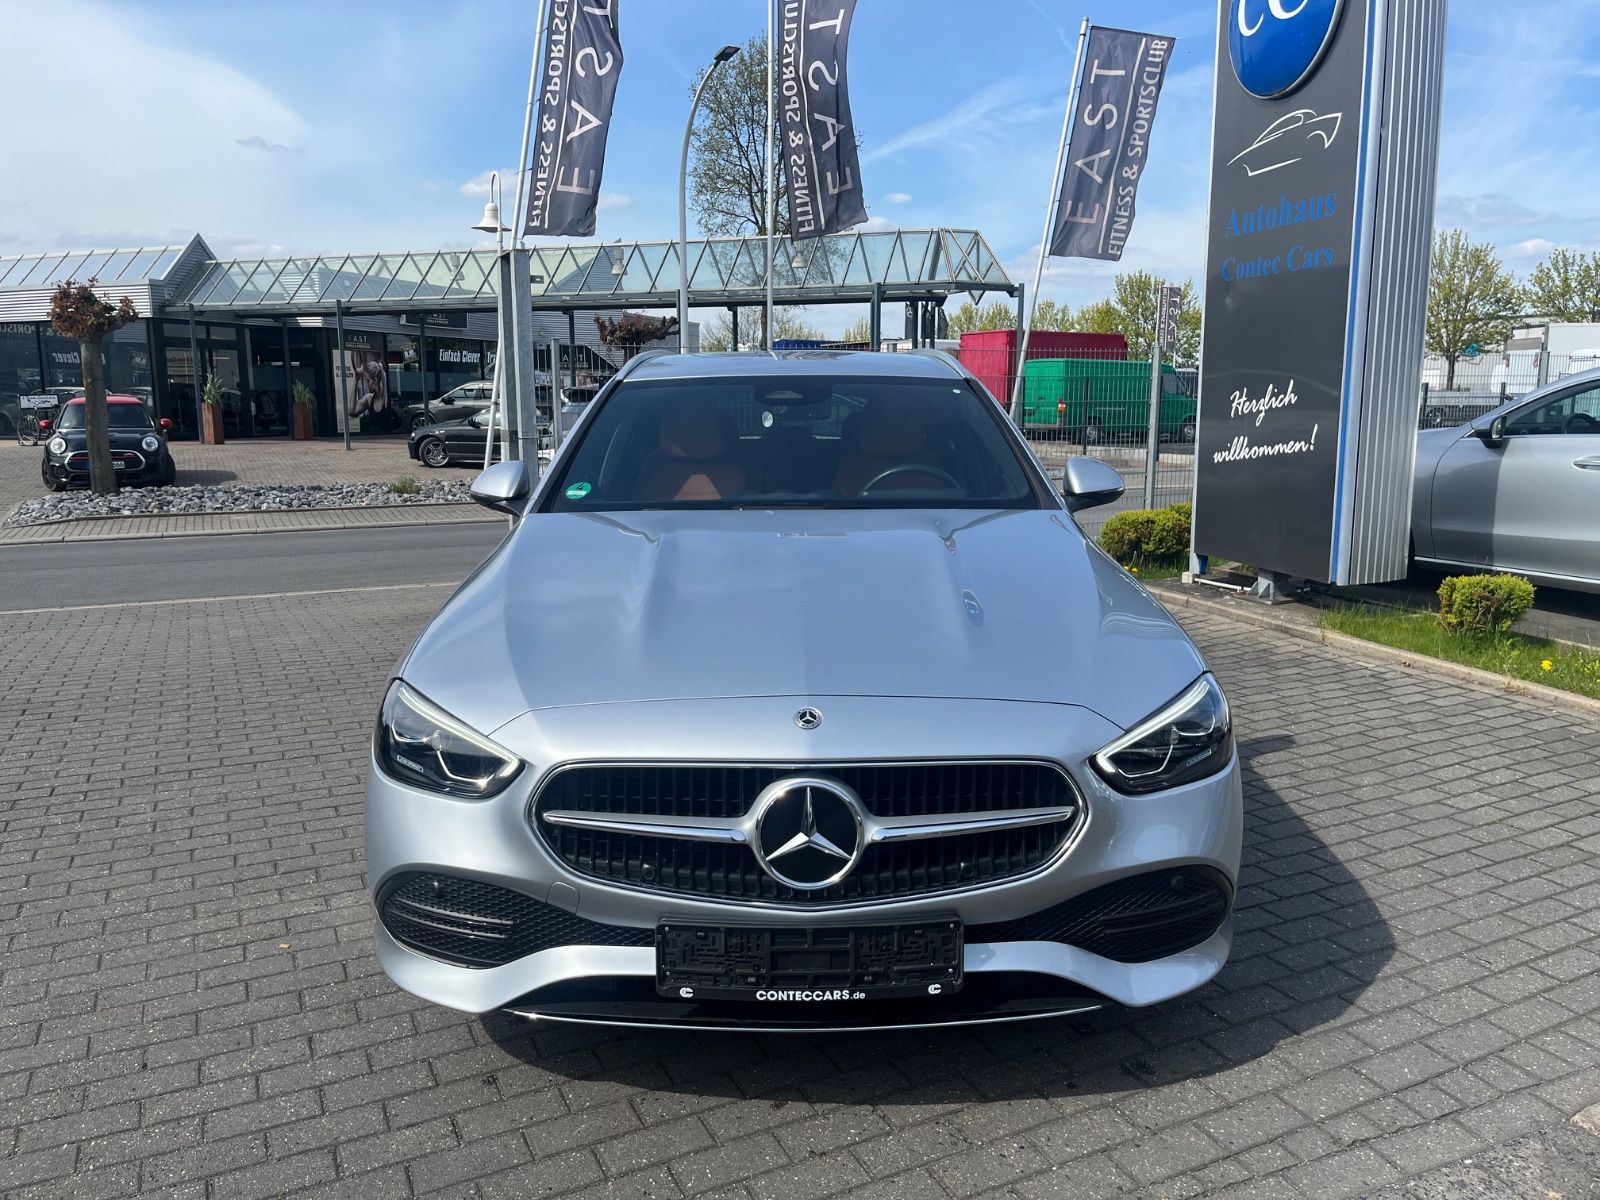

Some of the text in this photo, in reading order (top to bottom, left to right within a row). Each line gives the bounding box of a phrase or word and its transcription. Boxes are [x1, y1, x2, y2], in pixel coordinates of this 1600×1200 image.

[1066, 59, 1126, 224] EAST
[1108, 39, 1167, 255] FITNESS & SPORTSCLUB
[1224, 191, 1337, 238] Autohaus
[1221, 244, 1334, 281] Contec Cars
[439, 349, 461, 362] Einfach
[462, 351, 481, 363] Clever
[1230, 379, 1298, 426] Herzlich
[1213, 423, 1319, 463] willkommen!
[755, 989, 866, 1001] CONTECCARS.de
